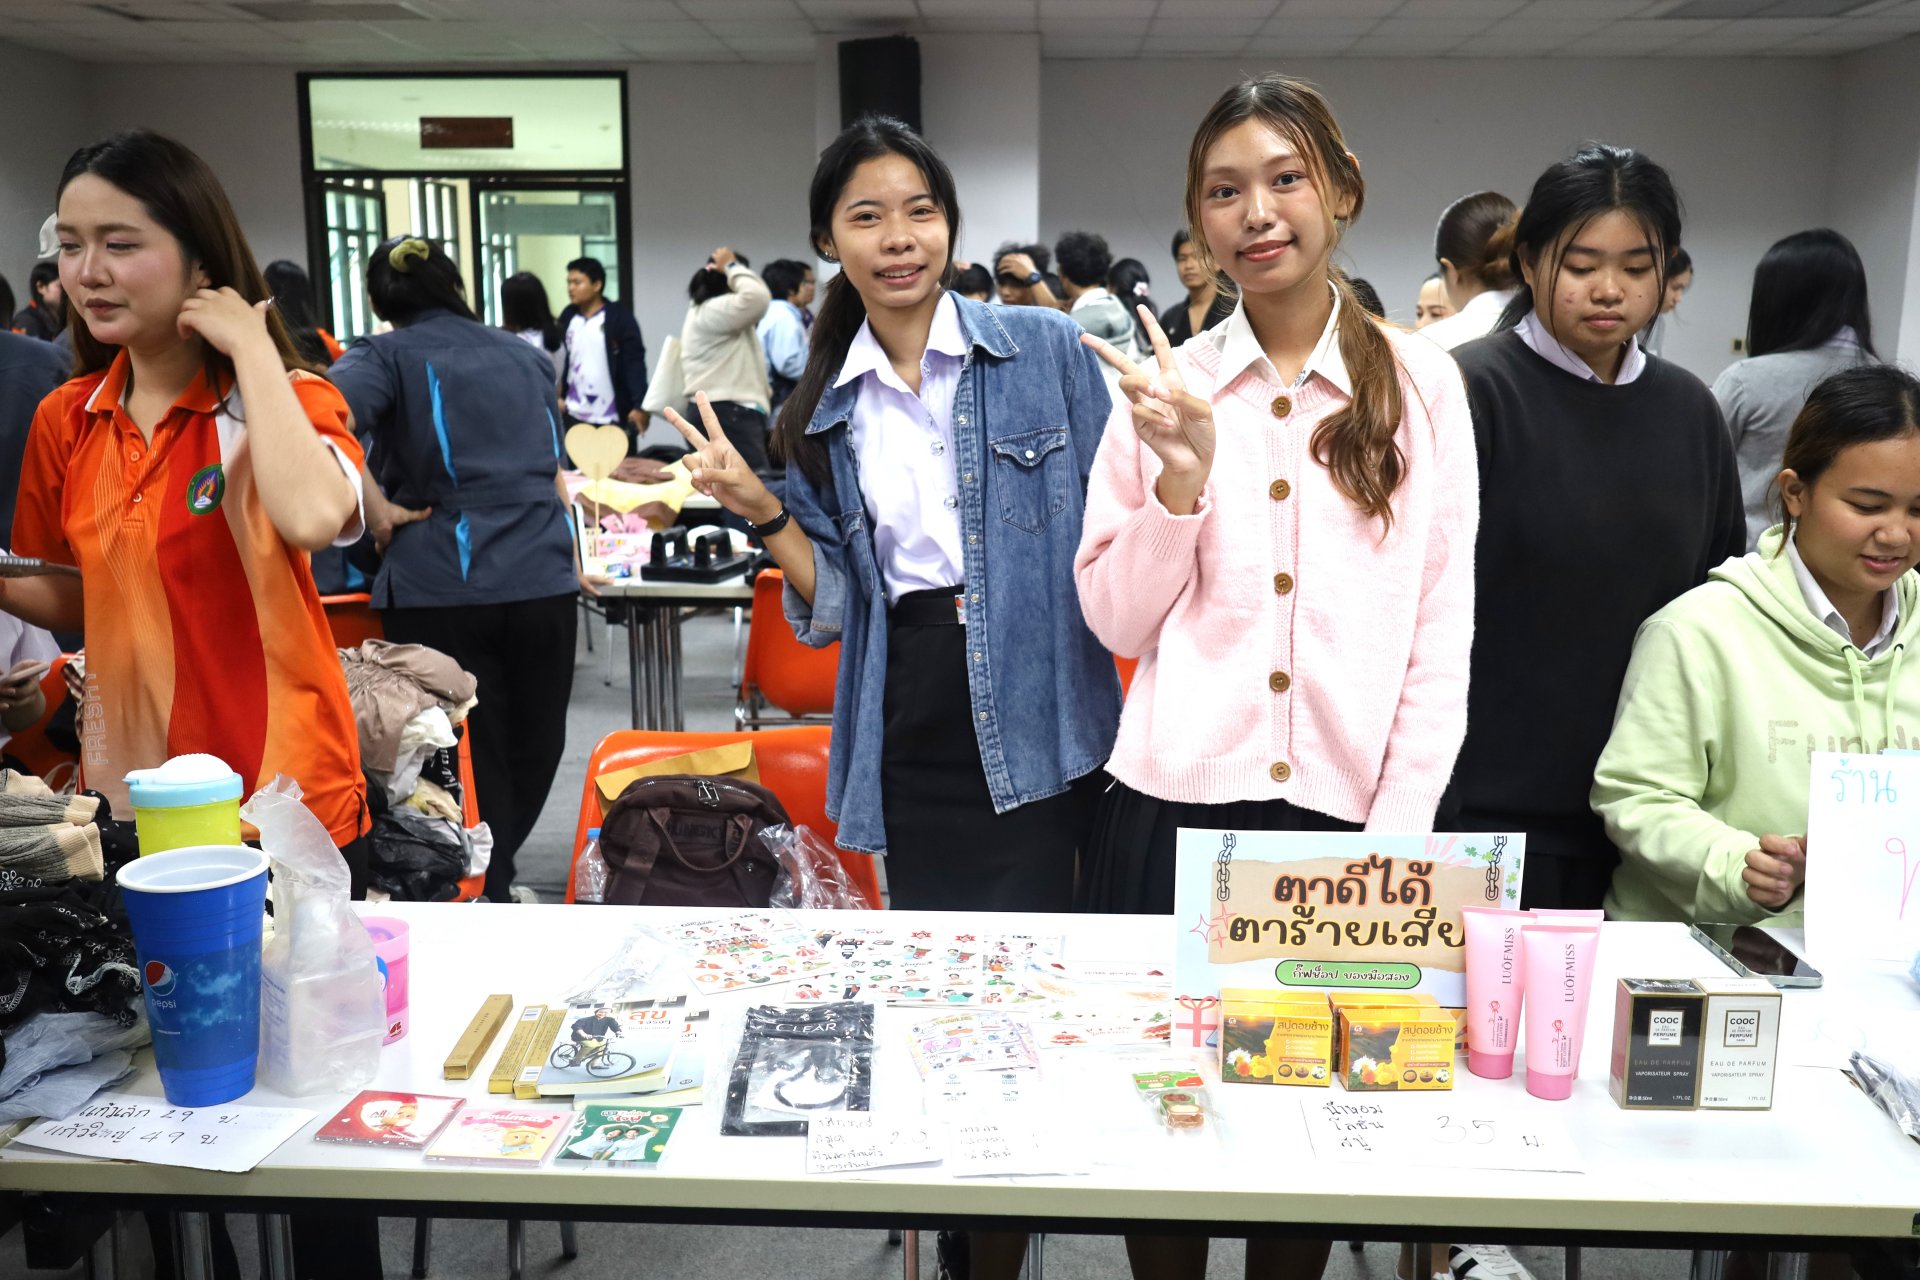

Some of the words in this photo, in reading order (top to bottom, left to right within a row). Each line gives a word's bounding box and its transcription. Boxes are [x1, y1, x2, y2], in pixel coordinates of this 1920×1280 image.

[1830, 758, 1897, 804] ร้าน
[1275, 854, 1433, 906] ตาดีได้
[1229, 905, 1466, 947] ตาร้ายเสีย
[151, 998, 177, 1010] pepsi
[629, 1009, 667, 1025] สุข
[1653, 1016, 1680, 1024] COOC
[775, 1022, 837, 1034] CLEAR
[1277, 1020, 1330, 1033] สบู่ดอยช้าง
[1402, 1024, 1454, 1038] สบู่ดอยช้าง
[43, 1121, 136, 1144] แก้วใหญ่
[140, 1130, 185, 1144] 49
[1430, 1115, 1496, 1145] 35
